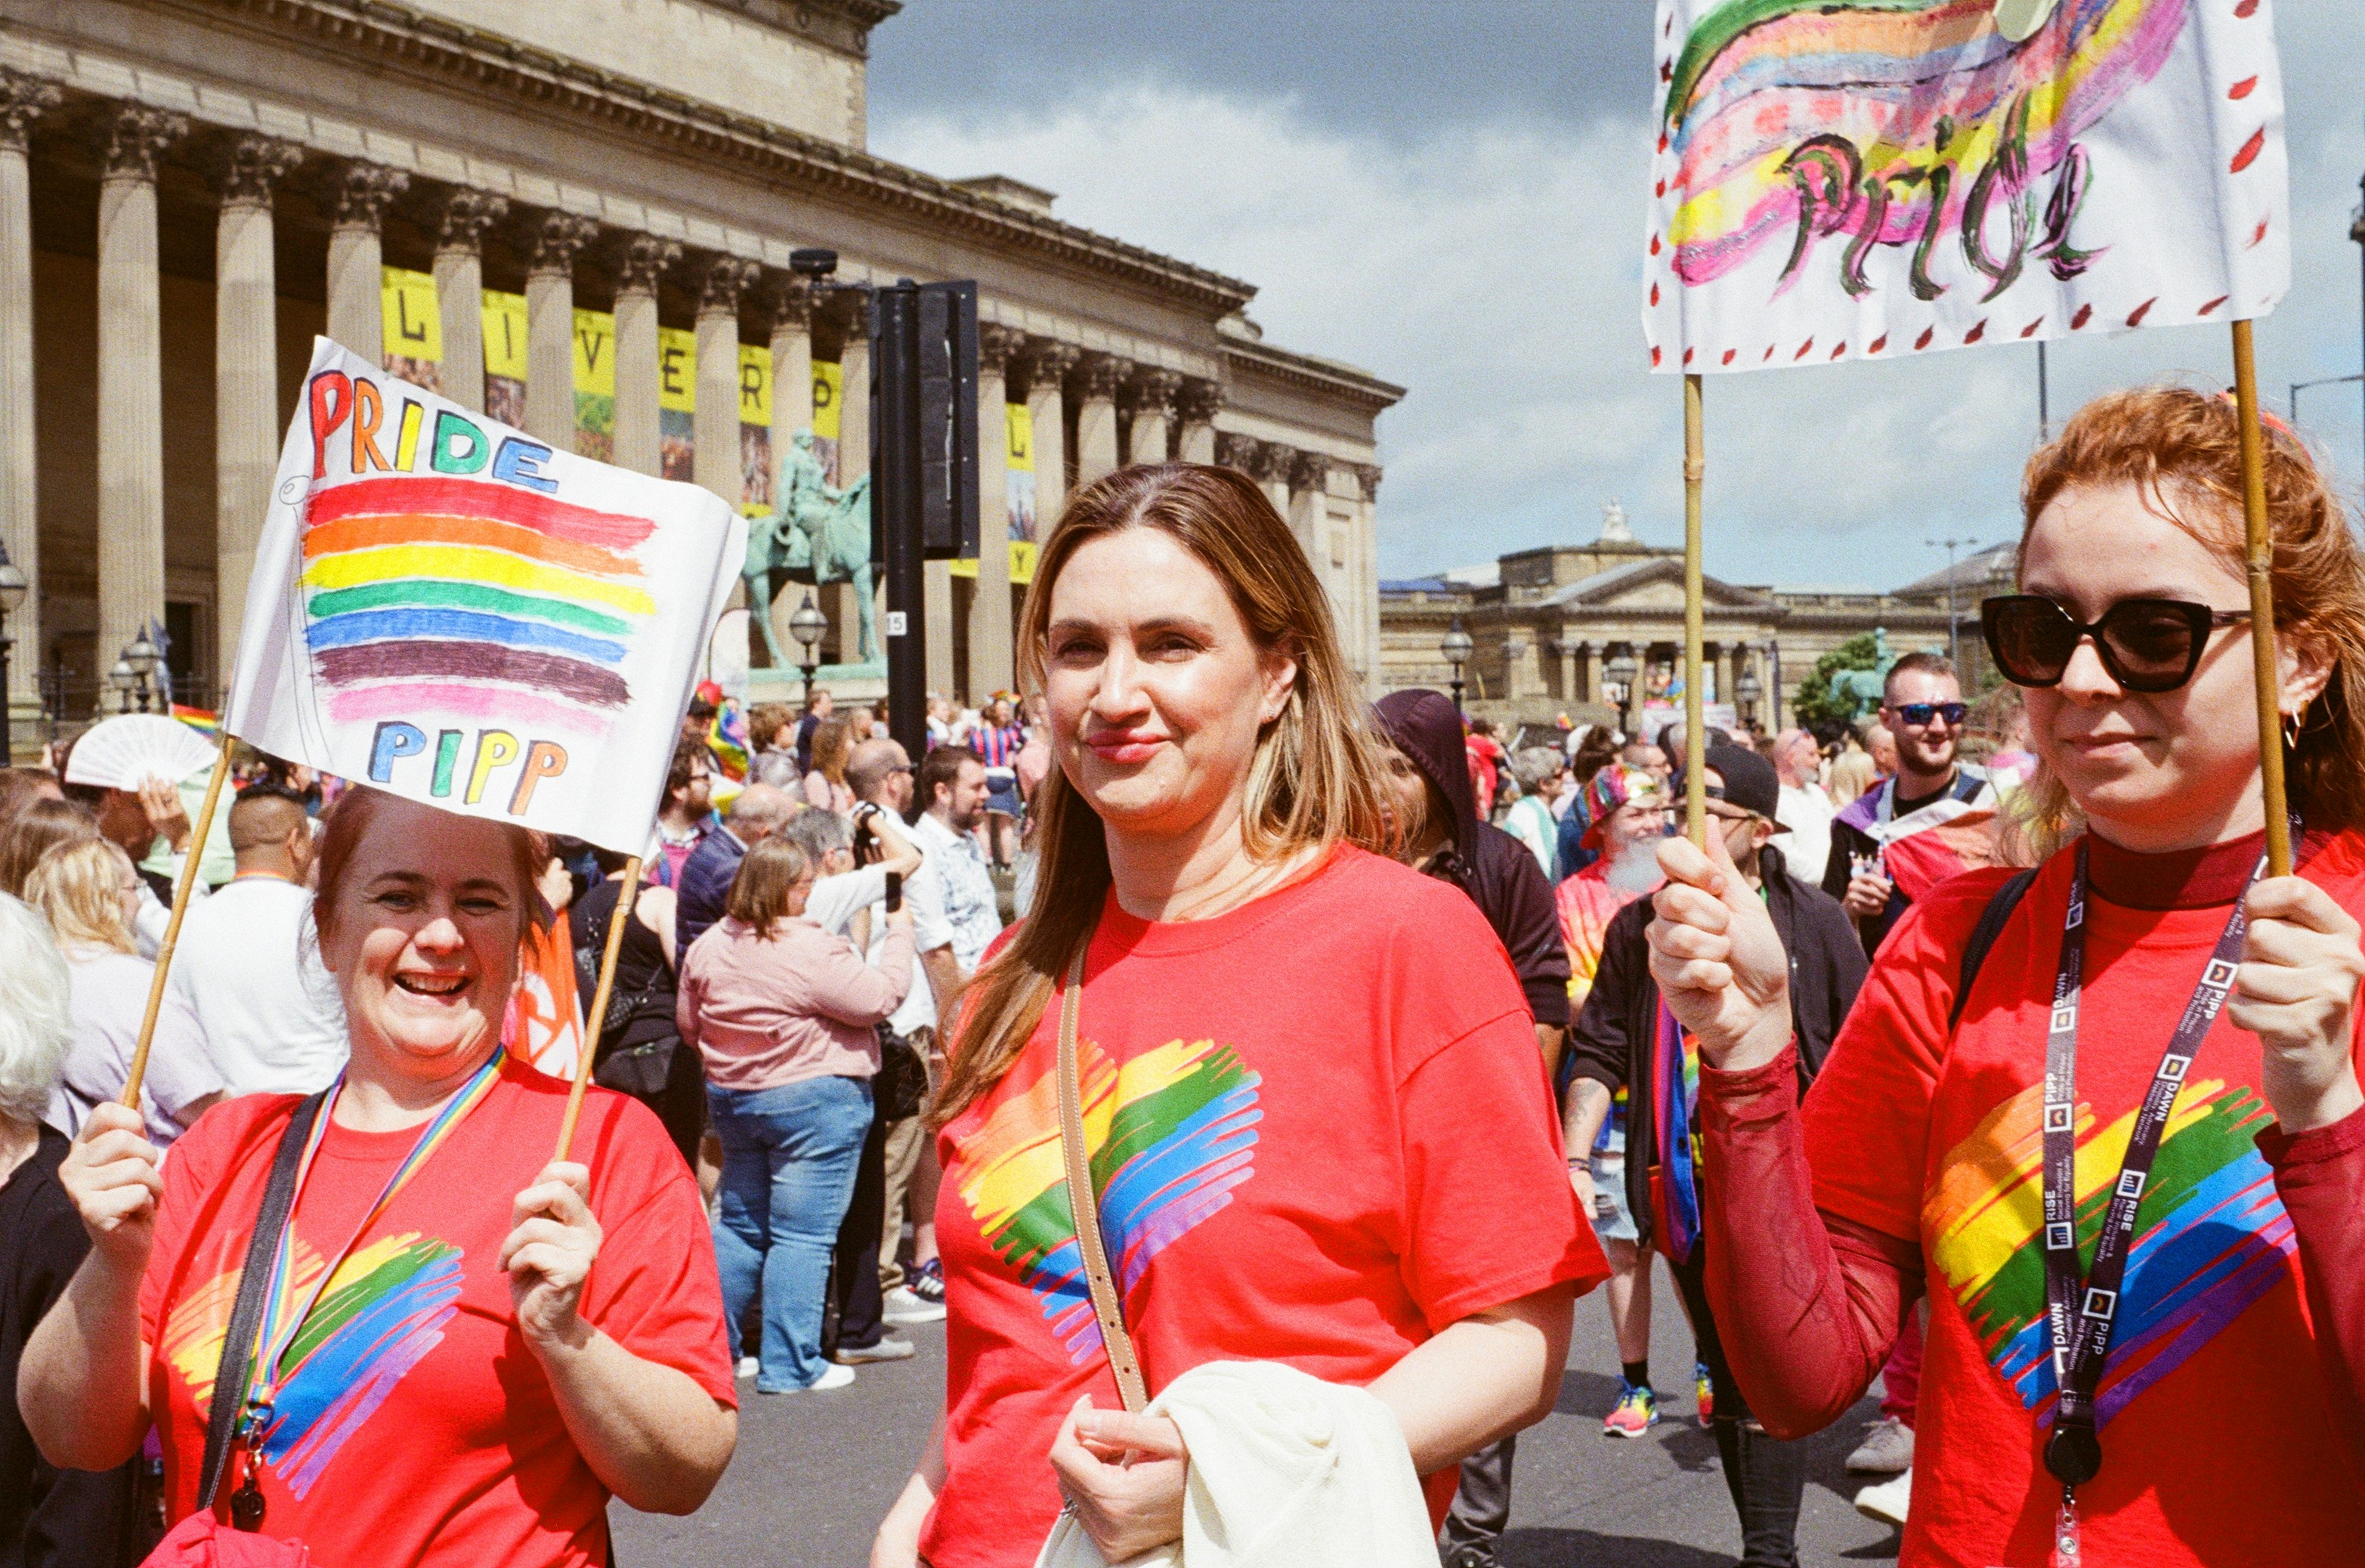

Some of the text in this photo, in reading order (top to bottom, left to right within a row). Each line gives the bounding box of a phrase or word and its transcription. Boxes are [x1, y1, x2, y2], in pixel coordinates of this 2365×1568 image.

[308, 370, 560, 493] PRIDE
[366, 721, 568, 816] PIPP
[2051, 972, 2067, 1008] DAWN
[2153, 1082, 2179, 1121] DAWN
[2044, 1189, 2056, 1220] RISE
[2119, 1199, 2138, 1231] RISE
[2049, 1302, 2066, 1345] DAWN
